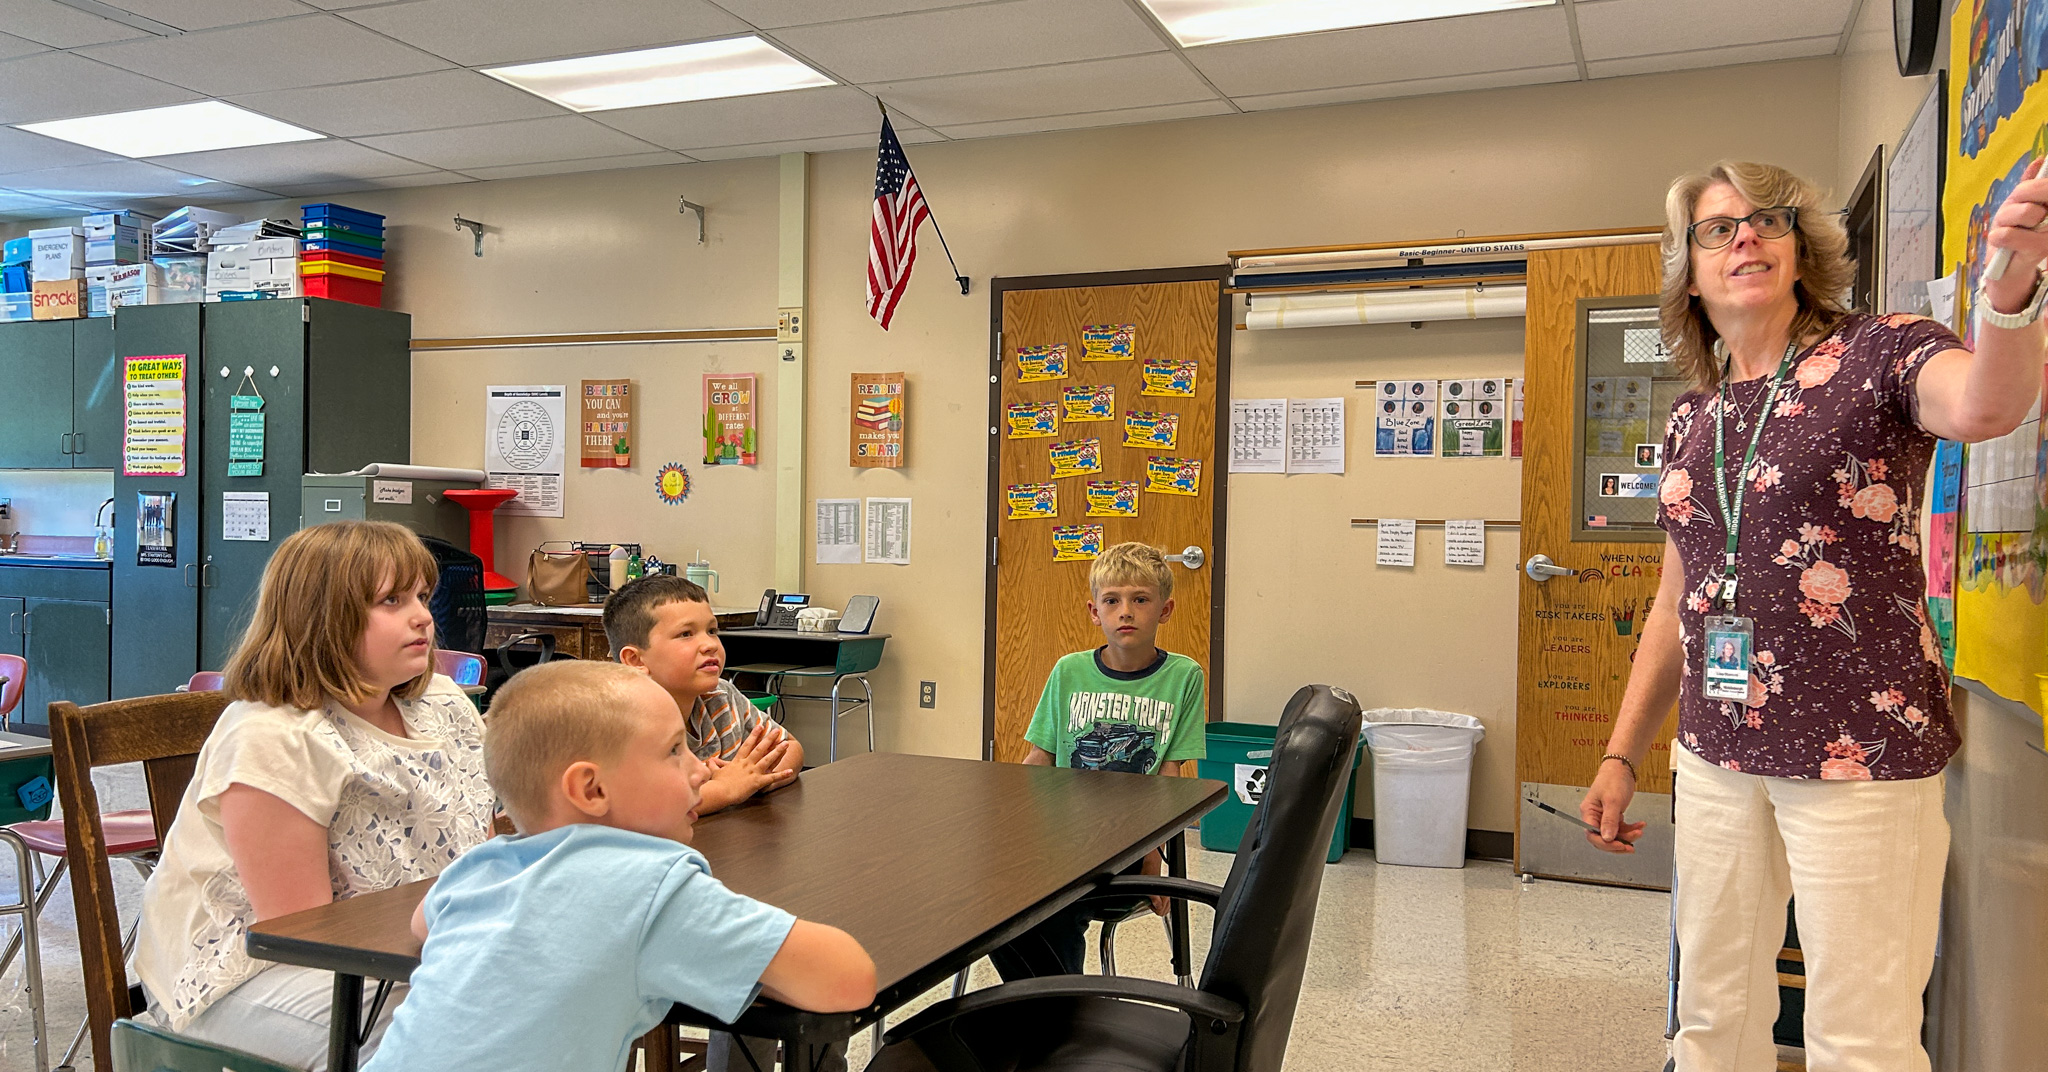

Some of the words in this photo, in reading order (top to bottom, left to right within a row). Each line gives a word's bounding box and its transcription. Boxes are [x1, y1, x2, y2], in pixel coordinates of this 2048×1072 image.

[38, 243, 68, 252] EMERGENCY
[1493, 243, 1525, 251] STATES
[45, 252, 62, 260] PLANS
[34, 290, 74, 307] snack
[128, 363, 136, 372] 10
[137, 362, 160, 370] GREAT
[162, 361, 182, 370] WAYS
[585, 385, 628, 396] BELIEVE
[858, 384, 902, 395] READING
[712, 391, 750, 404] GROW
[585, 399, 603, 409] YOU
[605, 399, 621, 409] CAN
[585, 422, 628, 432] HALFWAY
[1386, 418, 1404, 427] Blue
[1455, 420, 1475, 428] Green
[585, 434, 613, 446] THERE
[859, 432, 886, 440] makes
[887, 433, 900, 442] you
[857, 443, 901, 457] SHARP
[1620, 480, 1657, 490] WELCOME!
[1731, 487, 1745, 536] MIDDLEBURGH
[1738, 461, 1750, 490] KNIGHTS
[1600, 553, 1634, 564] WHEN
[1638, 555, 1661, 564] YOU
[1611, 565, 1664, 578] CLASS
[1555, 602, 1571, 611] you
[1535, 610, 1560, 620] RISK
[1564, 612, 1606, 621] TAKERS
[1552, 635, 1568, 643] you
[1543, 644, 1591, 654] LEADERS
[1548, 672, 1564, 681] you
[1537, 680, 1591, 691] EXPLORERS
[1564, 703, 1580, 712] you
[1067, 691, 1131, 733] MONSTER
[1133, 695, 1175, 745] TRUCK
[1555, 711, 1610, 723] THINKERS
[1572, 738, 1594, 747] YOU
